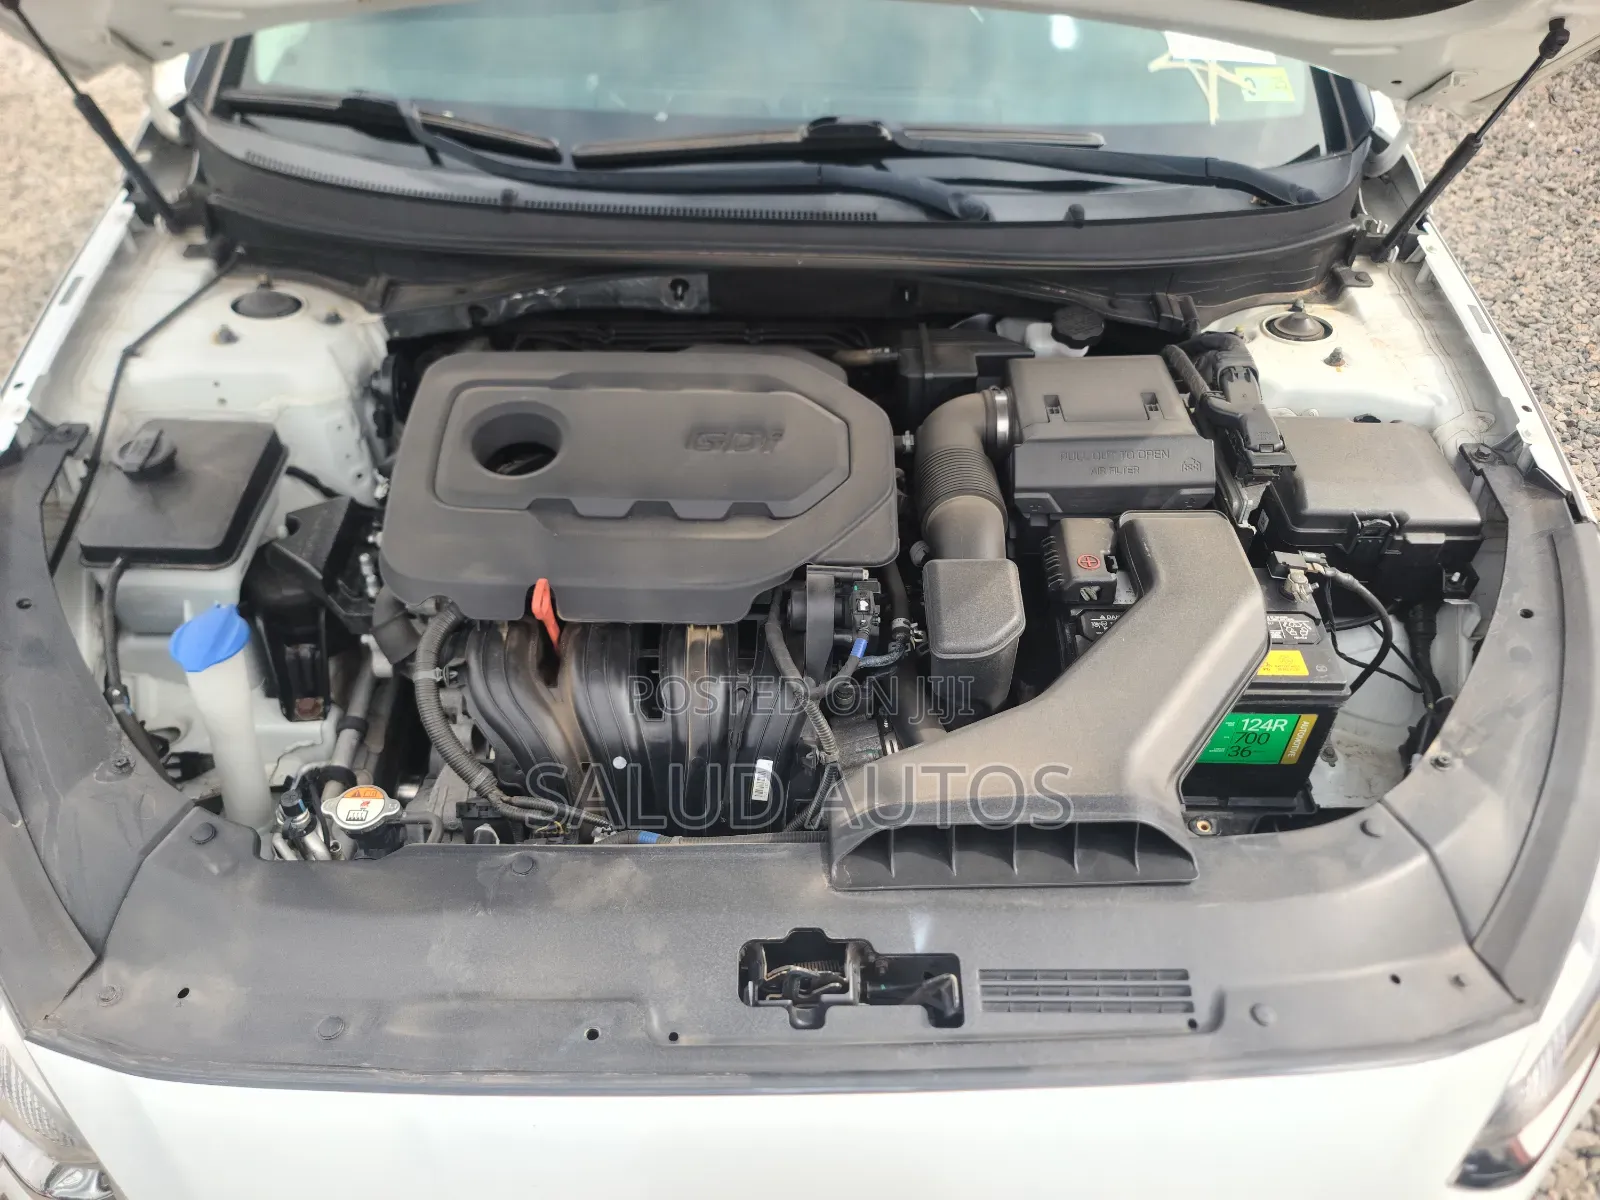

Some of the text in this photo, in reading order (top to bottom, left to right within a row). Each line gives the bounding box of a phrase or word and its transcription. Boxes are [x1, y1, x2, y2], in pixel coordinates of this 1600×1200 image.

[1060, 449, 1171, 462] PULL OUT TO OPEN
[1090, 465, 1140, 475] AIR FILTER
[1241, 718, 1288, 732] 124R
[1235, 732, 1271, 745] 700
[1287, 720, 1310, 758] AUTOMOTIVE
[1228, 745, 1252, 758] 36
